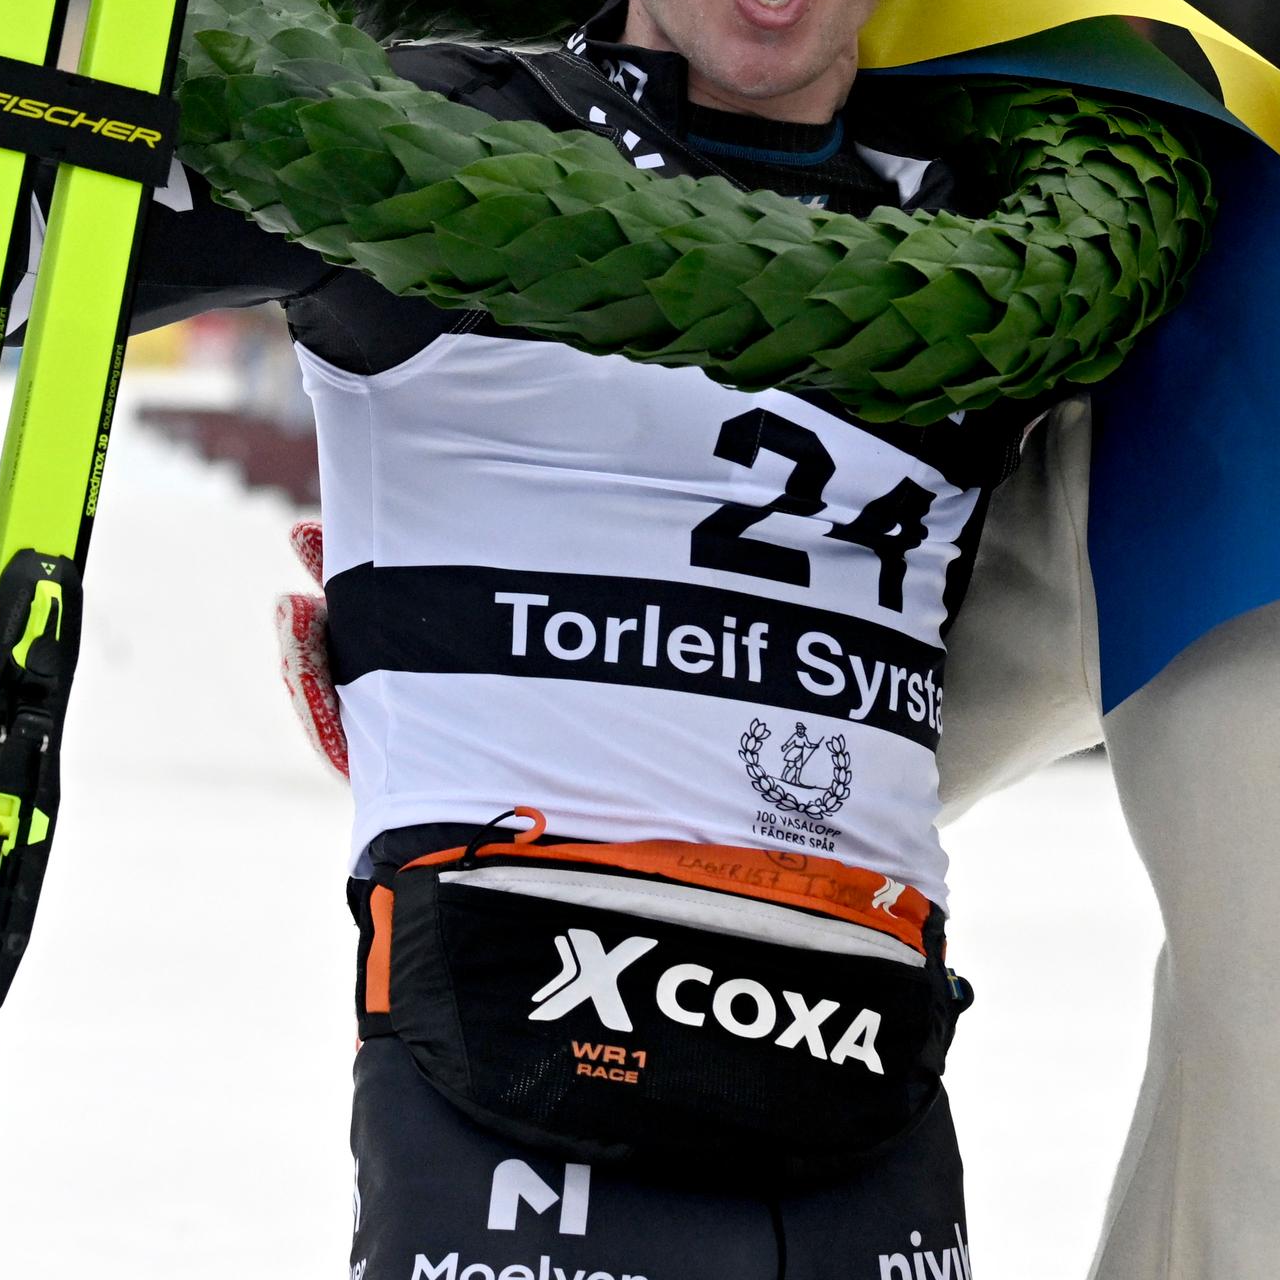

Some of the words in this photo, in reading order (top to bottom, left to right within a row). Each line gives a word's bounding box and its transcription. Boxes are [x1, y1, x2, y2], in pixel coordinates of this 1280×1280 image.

[85, 451, 106, 517] speedmax
[97, 434, 109, 450] 3D
[690, 407, 937, 612] 24
[494, 591, 768, 683] Torleif
[756, 810, 777, 824] 100
[780, 815, 842, 838] VASALOPP
[761, 824, 806, 846] FÄDERS
[809, 837, 836, 853] SPÅR
[656, 963, 885, 1075] COXA
[576, 1063, 639, 1084] RACE
